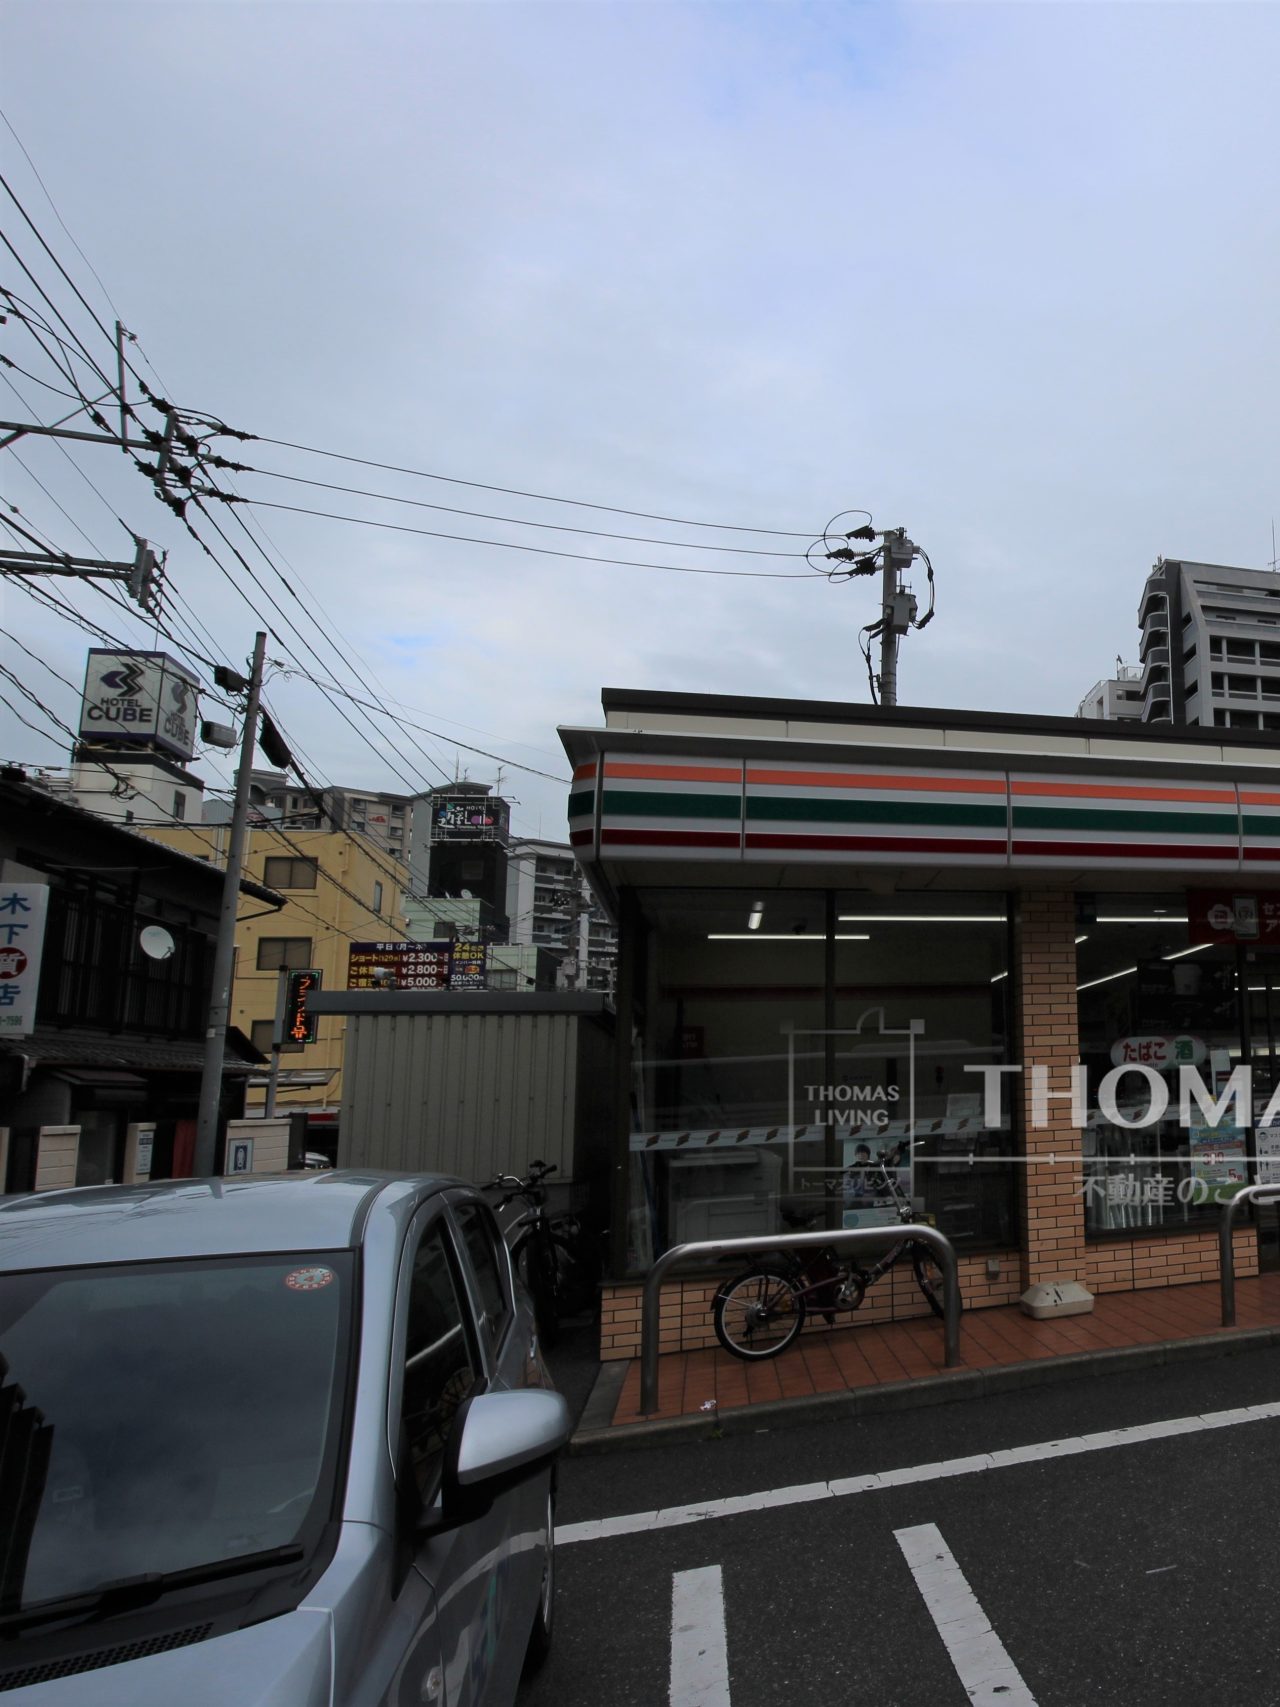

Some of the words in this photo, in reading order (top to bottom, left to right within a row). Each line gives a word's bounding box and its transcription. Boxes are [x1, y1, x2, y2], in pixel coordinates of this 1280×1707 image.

[100, 698, 142, 707] HOTEL
[87, 706, 153, 722] CUBE
[1123, 1042, 1167, 1062] たばこ
[1174, 1039, 1194, 1060] 酒
